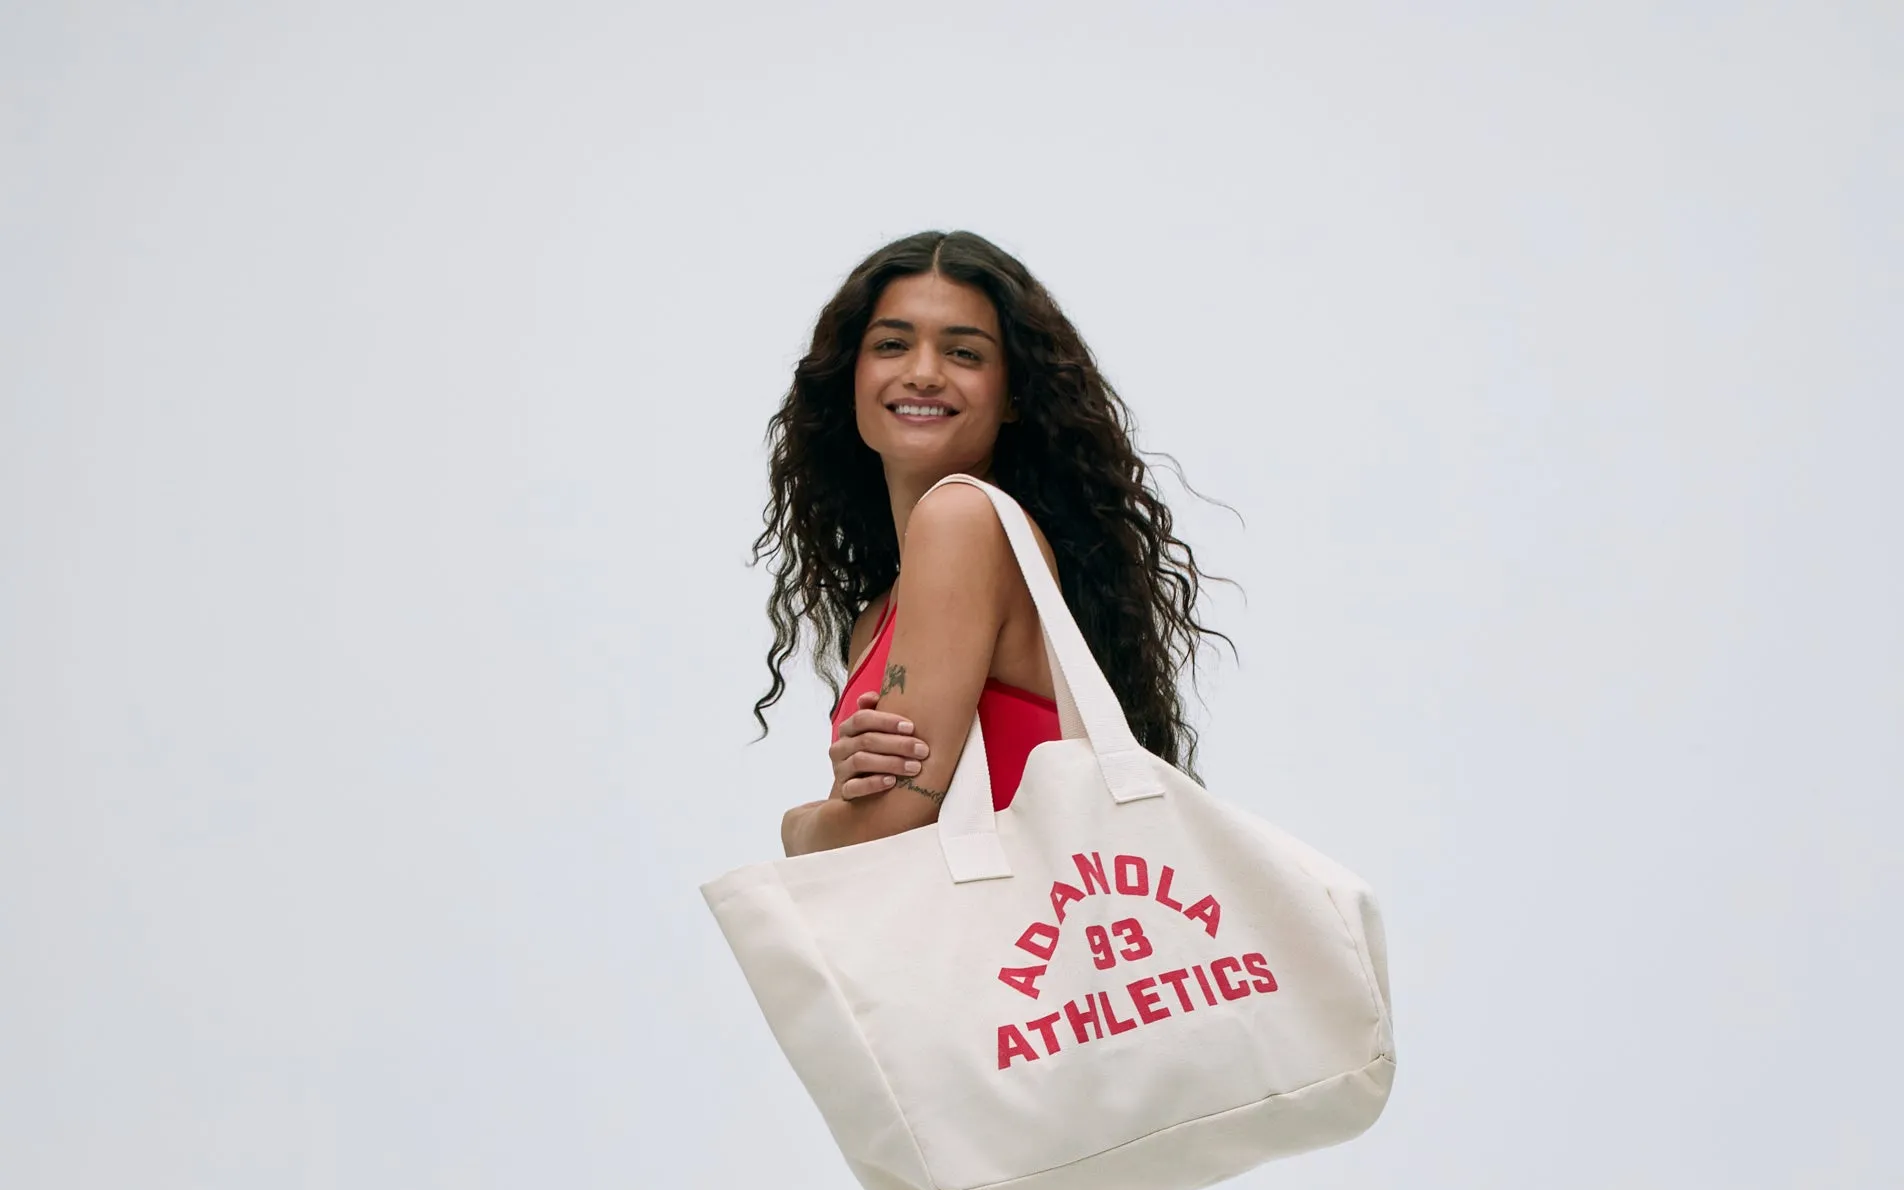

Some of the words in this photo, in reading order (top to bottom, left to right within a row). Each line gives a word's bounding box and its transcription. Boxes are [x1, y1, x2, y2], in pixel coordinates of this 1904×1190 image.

[998, 852, 1221, 999] ADANOLA
[1085, 917, 1153, 970] 93
[998, 952, 1278, 1070] ATHLETICS
